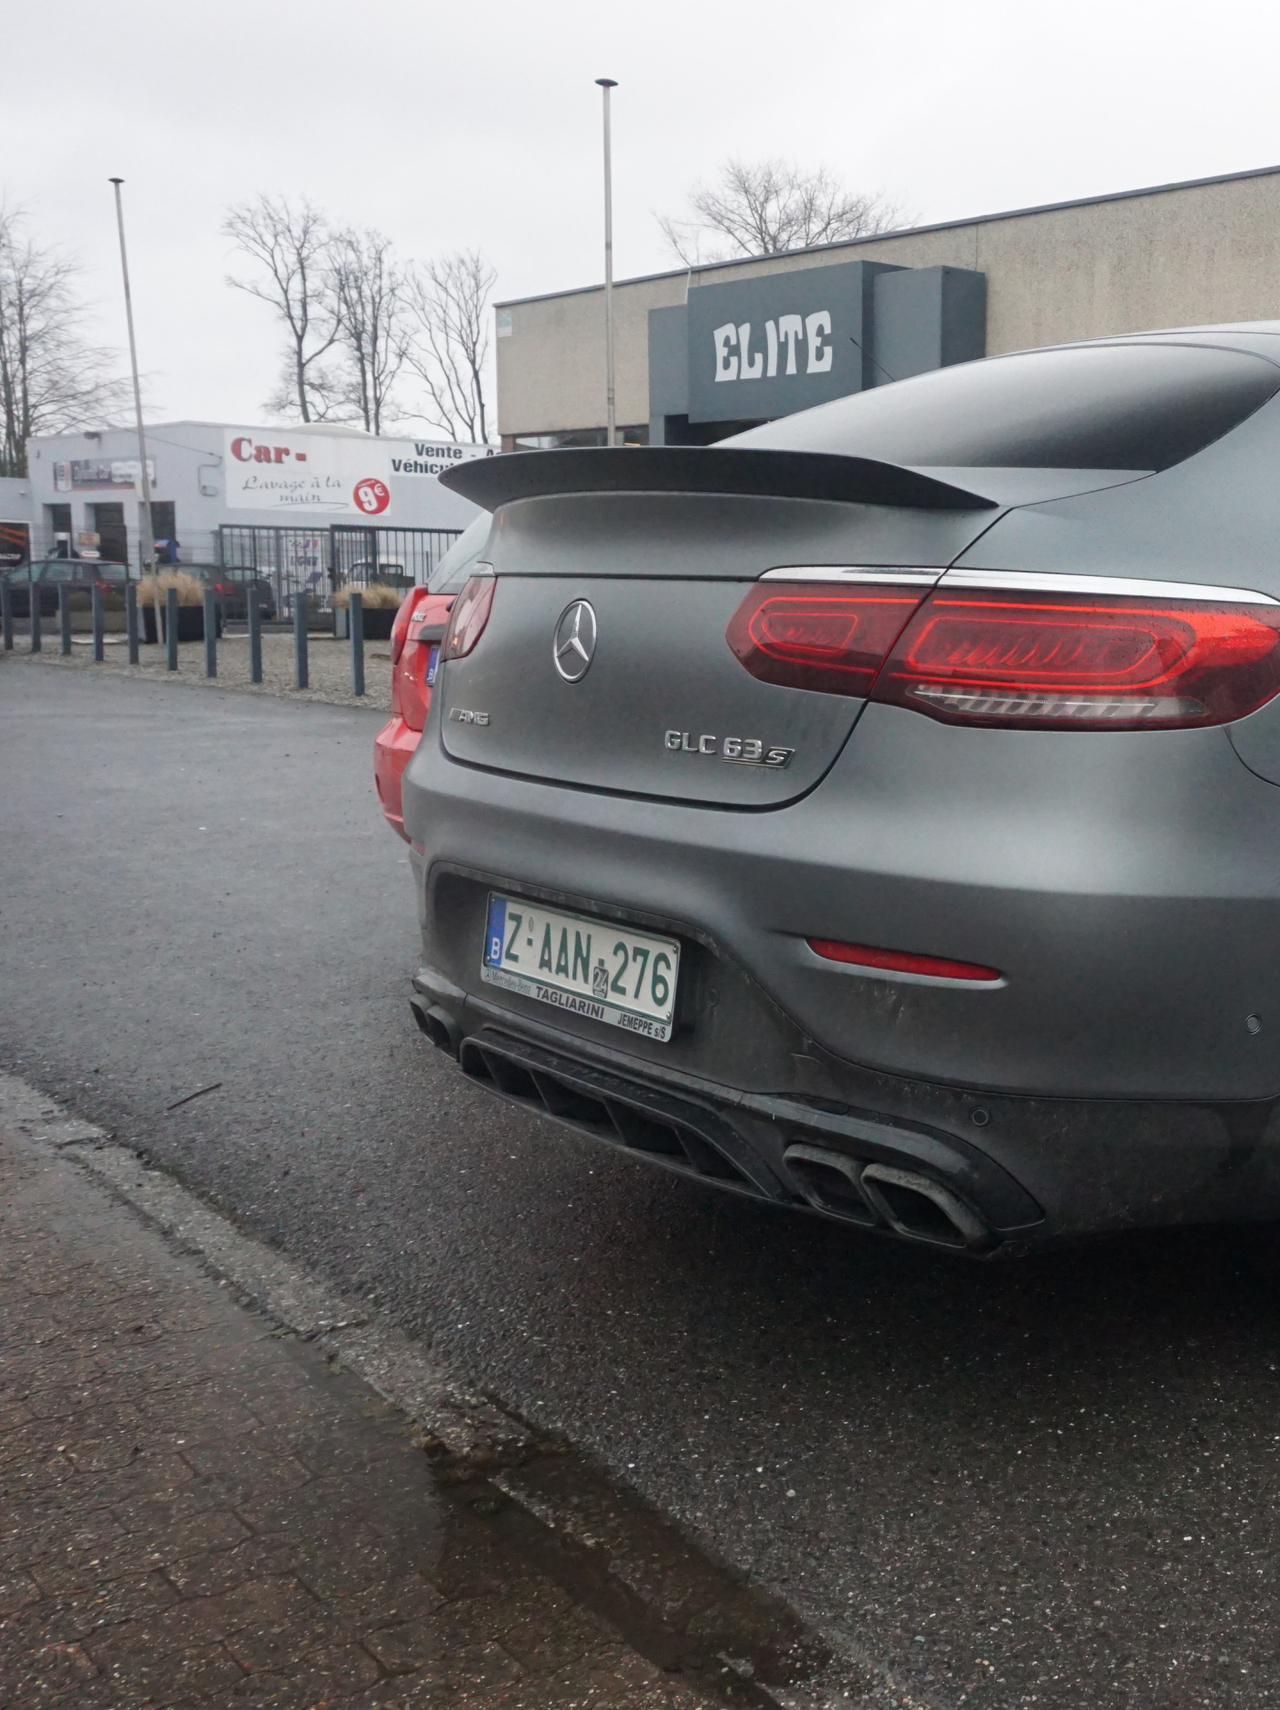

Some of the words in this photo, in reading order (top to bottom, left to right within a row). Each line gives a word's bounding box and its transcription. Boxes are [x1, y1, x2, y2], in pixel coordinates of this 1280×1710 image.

[713, 310, 833, 382] ELITE
[414, 443, 463, 459] Vente
[242, 476, 305, 492] Lavage
[325, 476, 341, 488] la
[279, 491, 321, 502] main
[664, 730, 717, 754] GLC
[490, 937, 501, 960] B
[535, 985, 605, 1020] TAGLIARINI
[617, 1013, 653, 1035] JEMEPPE
